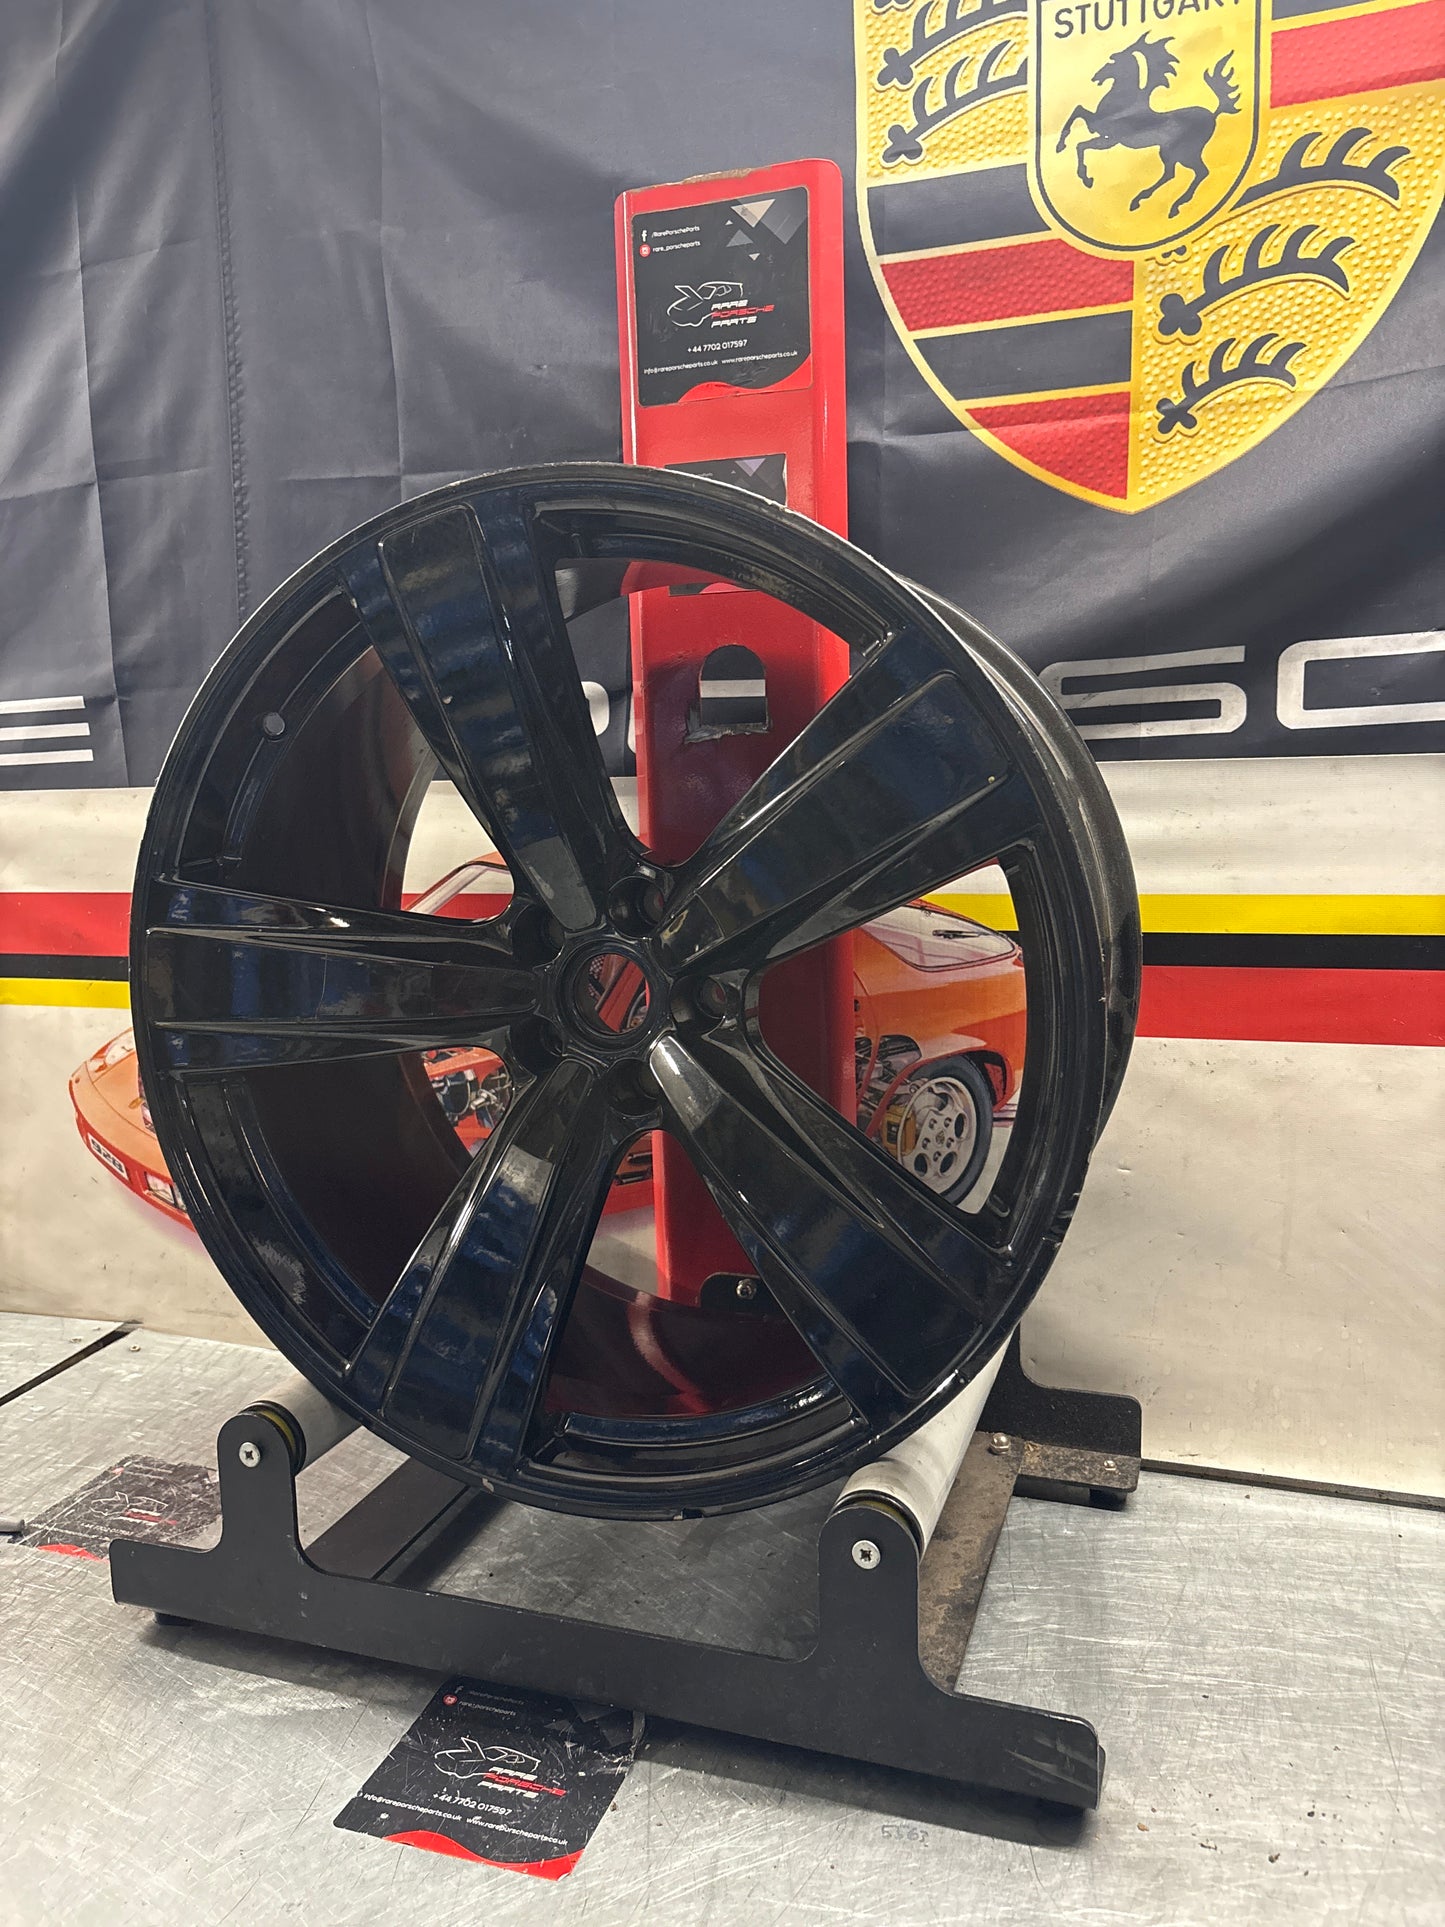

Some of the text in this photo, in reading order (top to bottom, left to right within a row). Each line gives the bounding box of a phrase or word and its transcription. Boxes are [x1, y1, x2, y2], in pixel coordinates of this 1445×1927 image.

[703, 342, 721, 352] 7702
[722, 339, 748, 350] 017597
[450, 1796, 477, 1809] 7702
[477, 1802, 512, 1816] 017597
